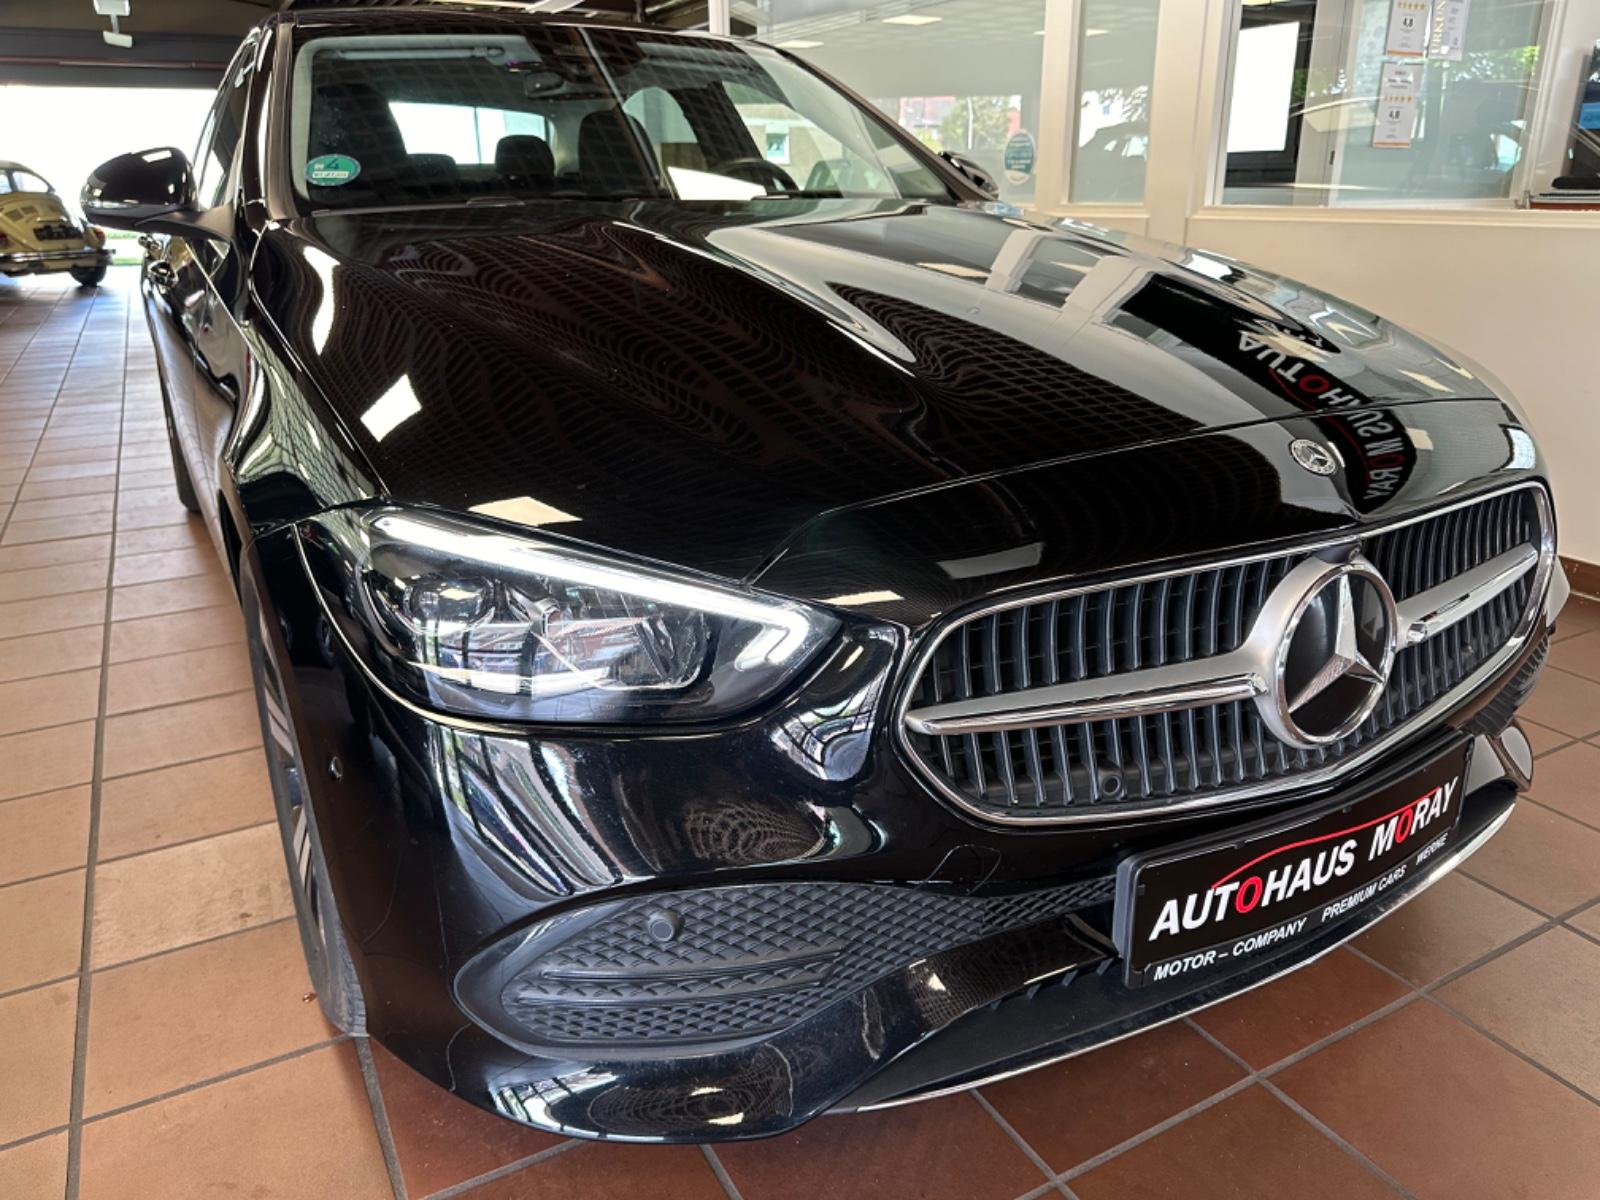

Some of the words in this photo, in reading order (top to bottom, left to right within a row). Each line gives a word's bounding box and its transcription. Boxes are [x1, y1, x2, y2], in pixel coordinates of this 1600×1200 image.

[1148, 839, 1358, 942] AUTOHAUS
[1367, 776, 1459, 862] MORAY
[1153, 950, 1216, 981] MOTOR
[1232, 916, 1308, 957] COMPANY
[1321, 881, 1377, 923] PREMIUM
[1377, 864, 1408, 892] CARS
